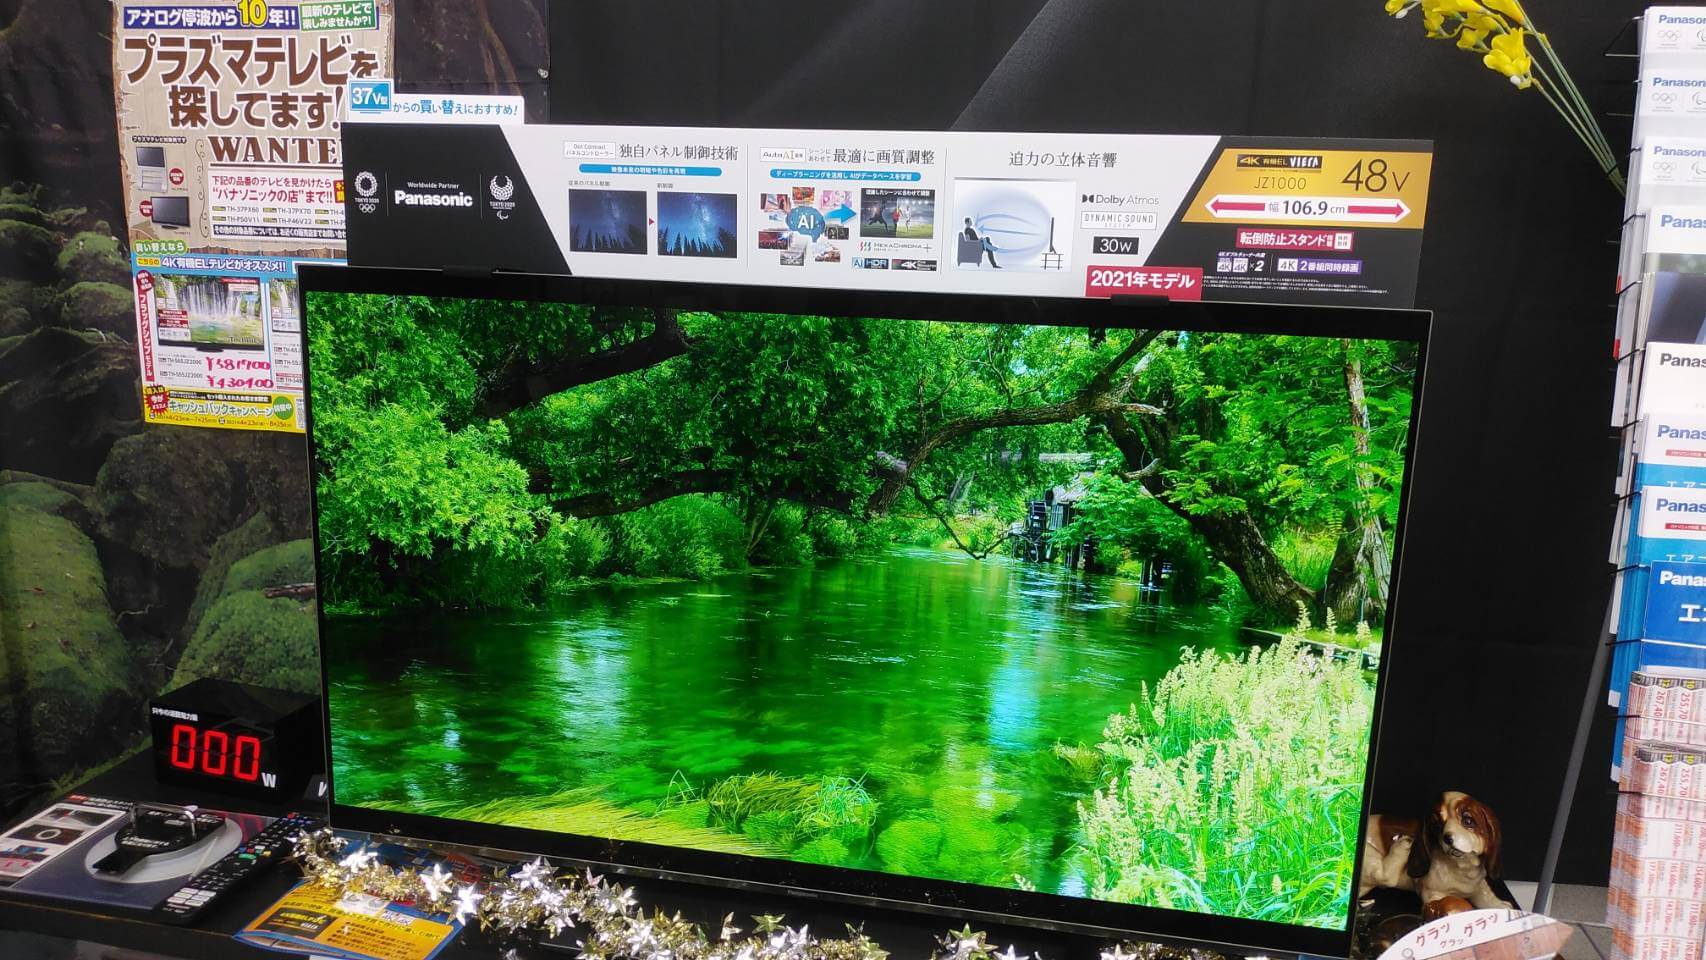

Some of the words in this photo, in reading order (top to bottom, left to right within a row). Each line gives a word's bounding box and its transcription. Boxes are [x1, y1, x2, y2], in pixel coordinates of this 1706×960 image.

[124, 34, 378, 86] プラズマテレビを
[207, 135, 342, 164] WANTE
[619, 143, 739, 161] 独自パネル制御技術
[833, 148, 935, 165] 最適に画質調整
[1008, 151, 1118, 169] 迫力の立体音響
[1239, 156, 1260, 165] 4K
[212, 175, 332, 188] 下記の品番のテレビを見かけたら
[407, 181, 438, 189] Worldwide
[438, 182, 459, 190] Partner
[1254, 176, 1307, 190] JZ1000
[394, 190, 473, 207] Panasonic
[1096, 194, 1125, 206] Dolby
[1127, 195, 1160, 205] Atmos
[1268, 202, 1280, 213] 幅
[797, 216, 814, 229] AI
[1084, 213, 1122, 223] DYNAMIC
[1125, 214, 1154, 223] SOUND
[853, 259, 863, 268] AI
[901, 261, 917, 269] 4K
[1280, 260, 1298, 270] 4K
[1090, 270, 1195, 290] 2021年モデル
[1654, 690, 1666, 720] 267,40
[1680, 692, 1691, 721] 255,70
[170, 724, 261, 782] 000
[261, 772, 277, 788] W
[1416, 922, 1450, 948] グラッ
[1463, 912, 1498, 937] グラッ
